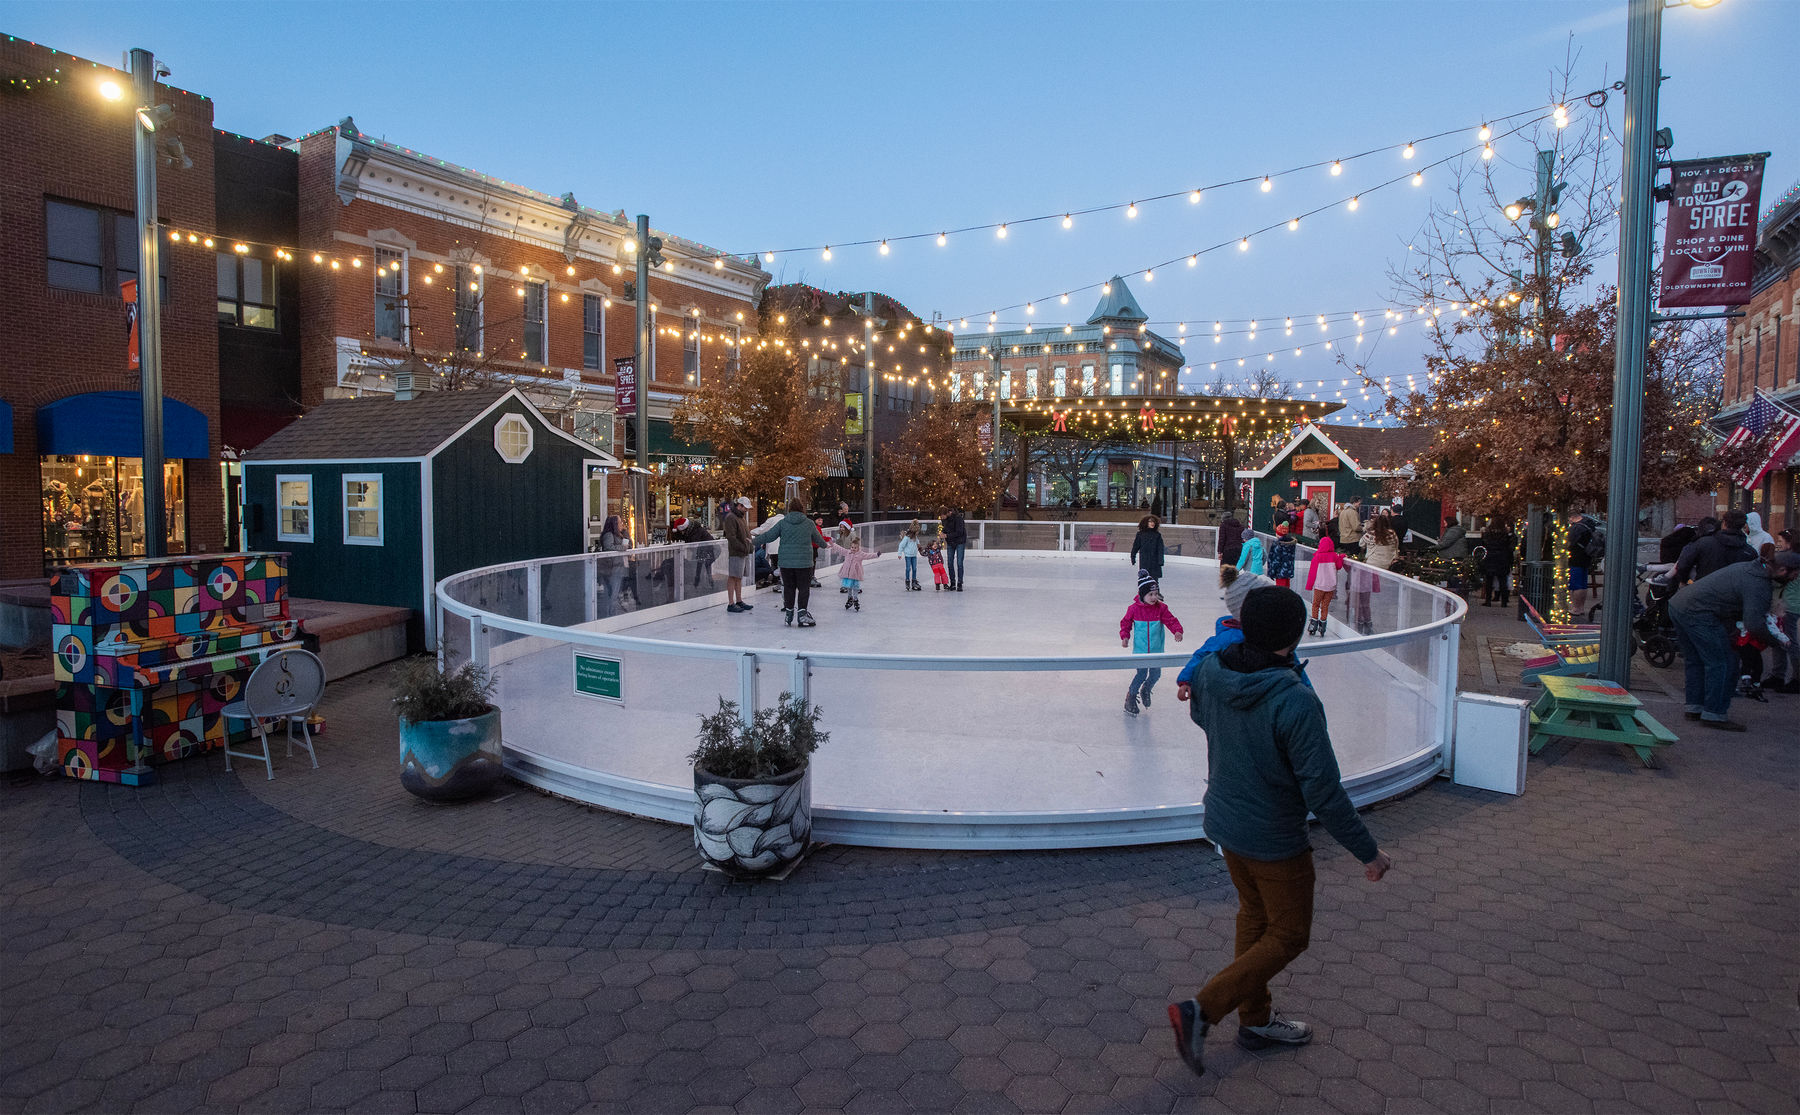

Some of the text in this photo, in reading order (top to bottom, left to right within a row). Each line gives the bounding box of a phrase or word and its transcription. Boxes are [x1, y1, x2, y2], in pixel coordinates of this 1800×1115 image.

[1718, 166, 1740, 174] DEC.
[1693, 181, 1720, 194] OLD
[1677, 193, 1719, 207] TOWN
[1689, 203, 1751, 230] SPREE
[1676, 237, 1705, 245] SHOP
[1719, 234, 1744, 242] DINE
[1670, 244, 1749, 255] LOCAL TO WIN!
[1665, 281, 1747, 290] OLDTOWNSPREE.COM
[688, 456, 708, 464] SPORTS
